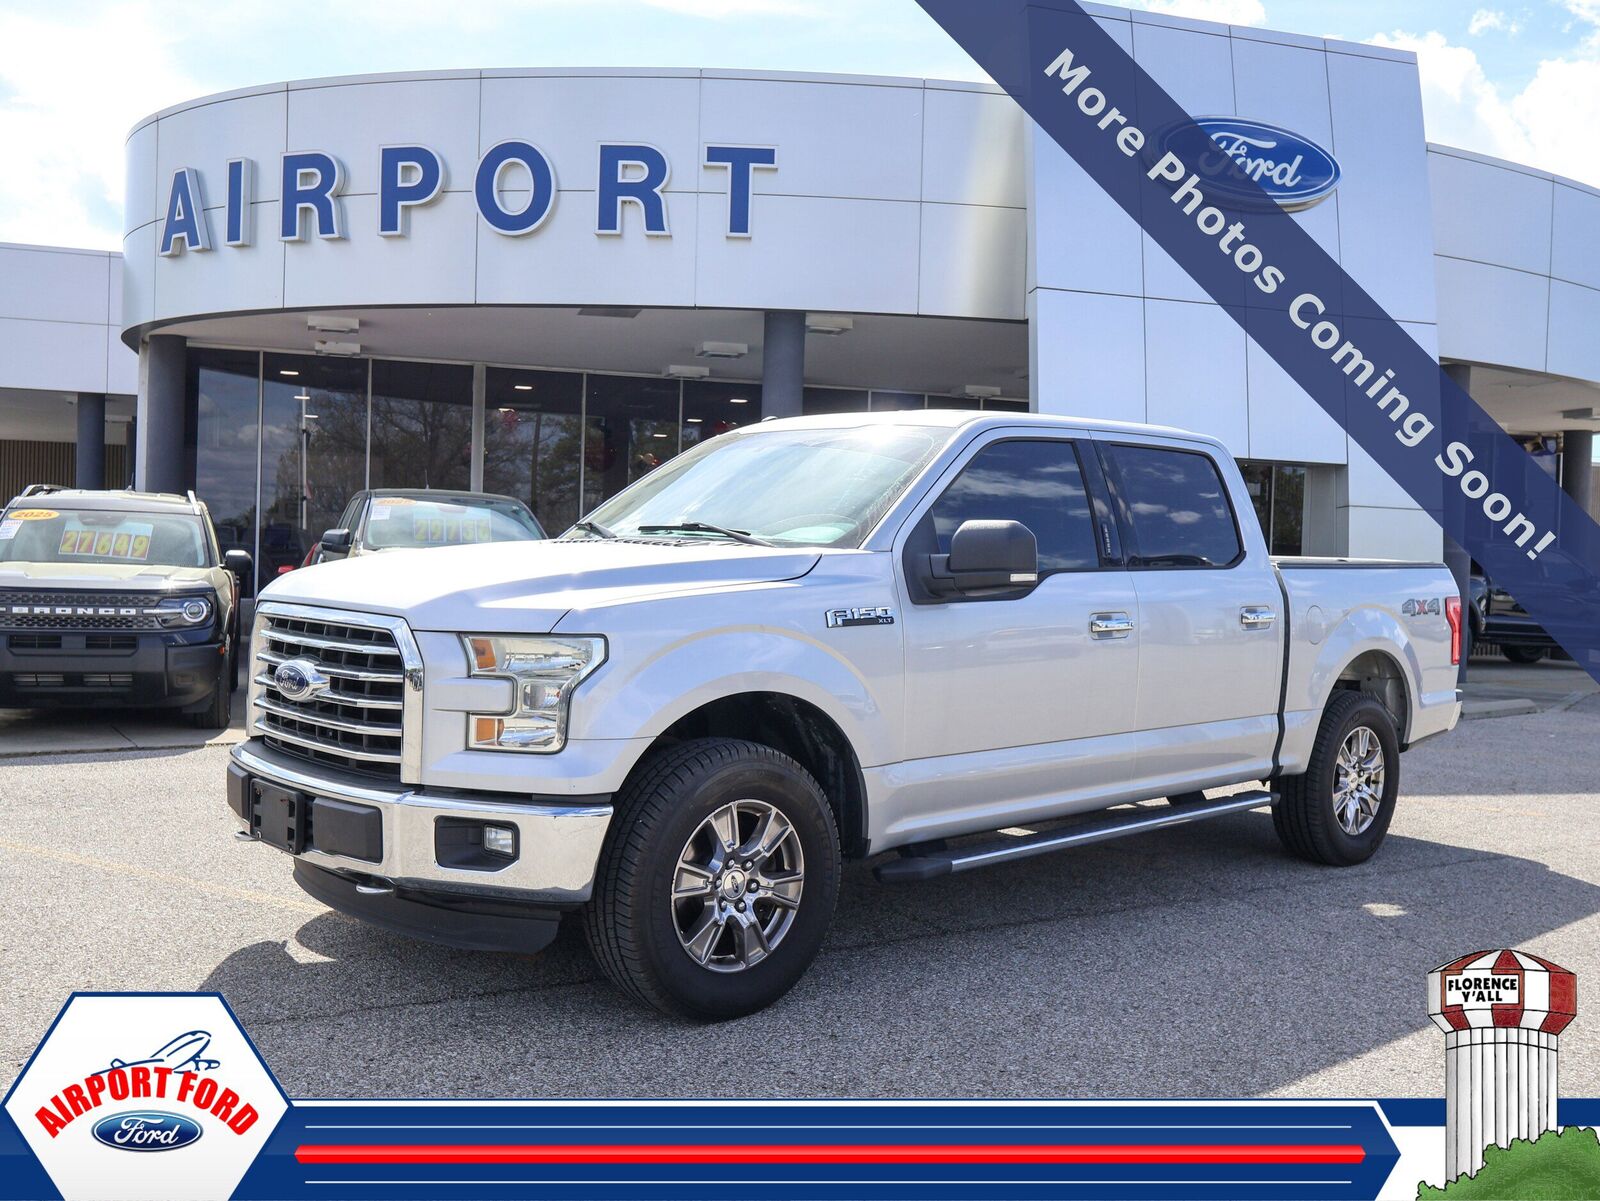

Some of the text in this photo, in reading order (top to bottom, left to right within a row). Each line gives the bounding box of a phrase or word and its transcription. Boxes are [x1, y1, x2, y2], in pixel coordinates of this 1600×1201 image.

[1198, 131, 1304, 187] Ford
[158, 138, 779, 257] AIRPORT
[60, 530, 149, 558] 27649
[12, 606, 136, 615] BRONCO
